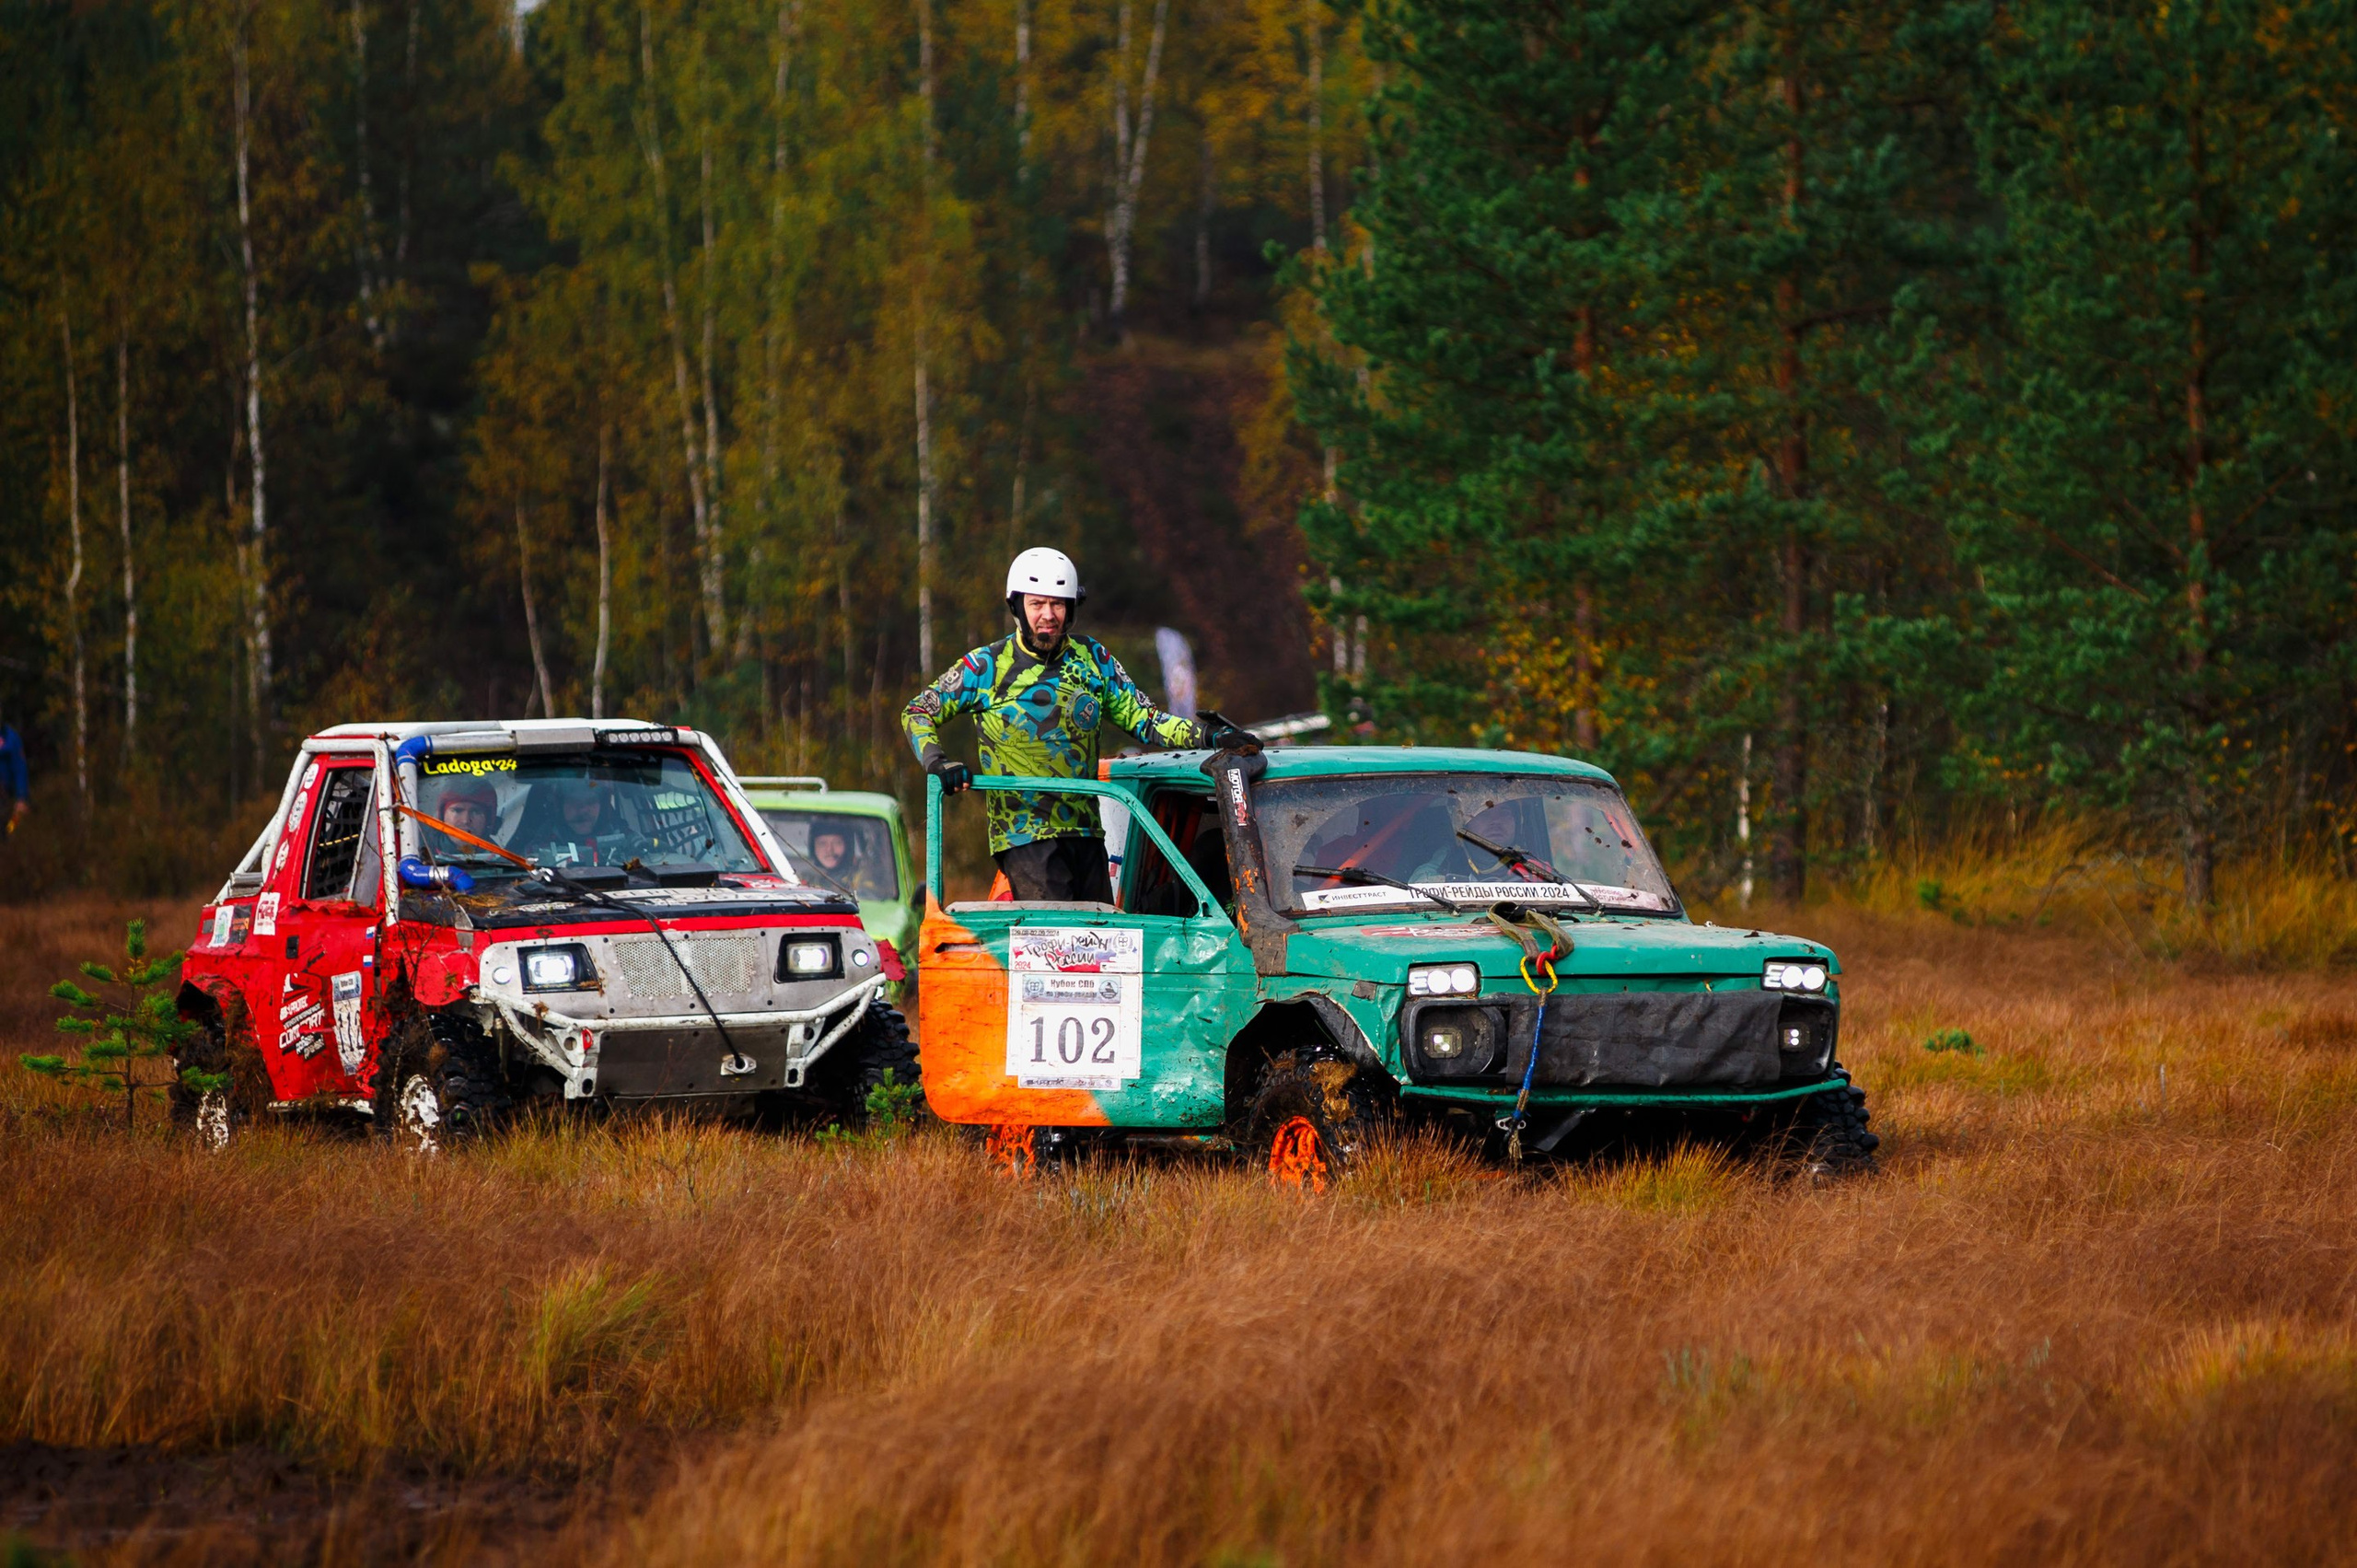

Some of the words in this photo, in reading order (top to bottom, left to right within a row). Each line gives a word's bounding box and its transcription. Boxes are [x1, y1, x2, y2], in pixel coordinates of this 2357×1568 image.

[424, 759, 517, 777] Ladoga'24
[1014, 961, 1031, 970] 2024
[1051, 980, 1076, 988] Кубок
[1029, 1016, 1115, 1063] 102
